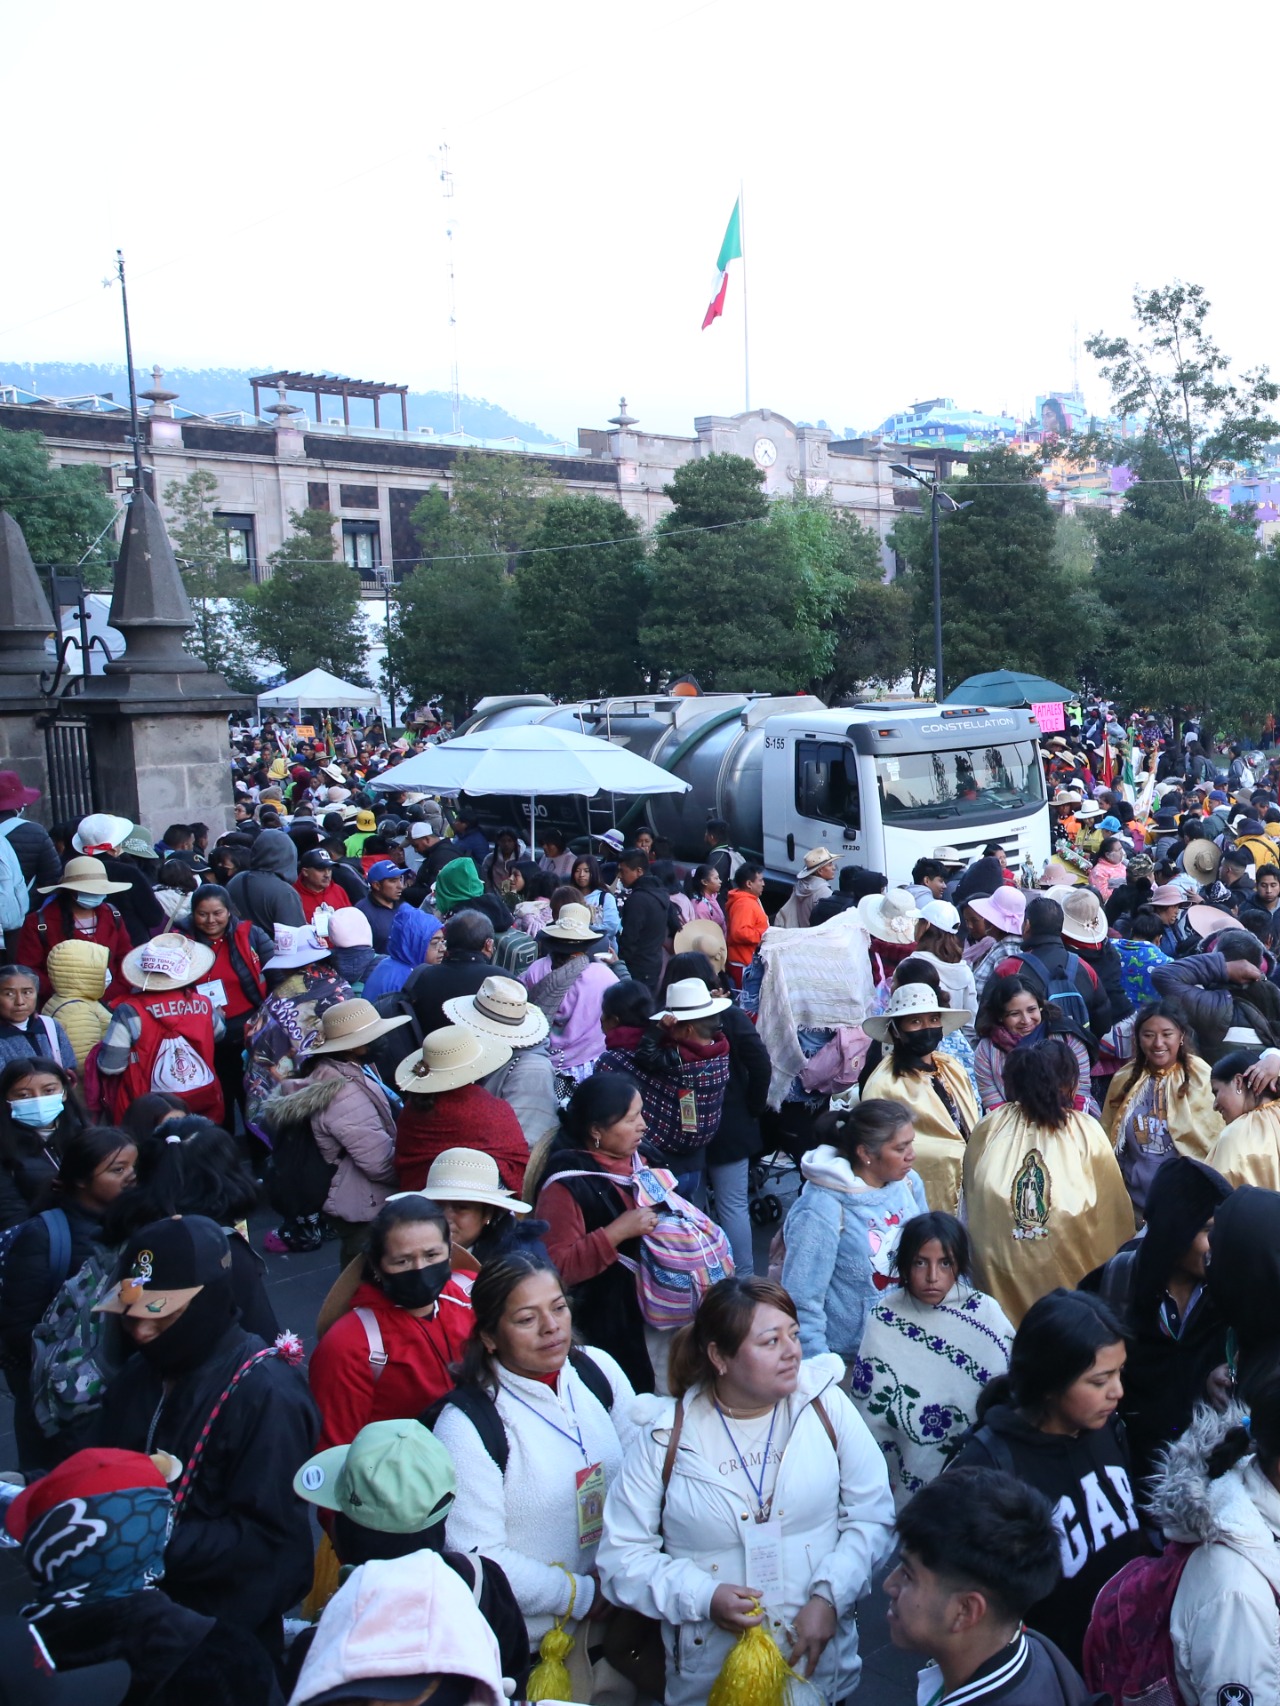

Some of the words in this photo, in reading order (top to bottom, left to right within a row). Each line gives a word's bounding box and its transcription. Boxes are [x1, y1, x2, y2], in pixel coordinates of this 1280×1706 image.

[1033, 703, 1062, 718] TAMALES
[921, 717, 1014, 733] CONSTELLATION
[1038, 718, 1059, 731] TOLE
[765, 737, 785, 750] S-155
[521, 804, 548, 818] EDO
